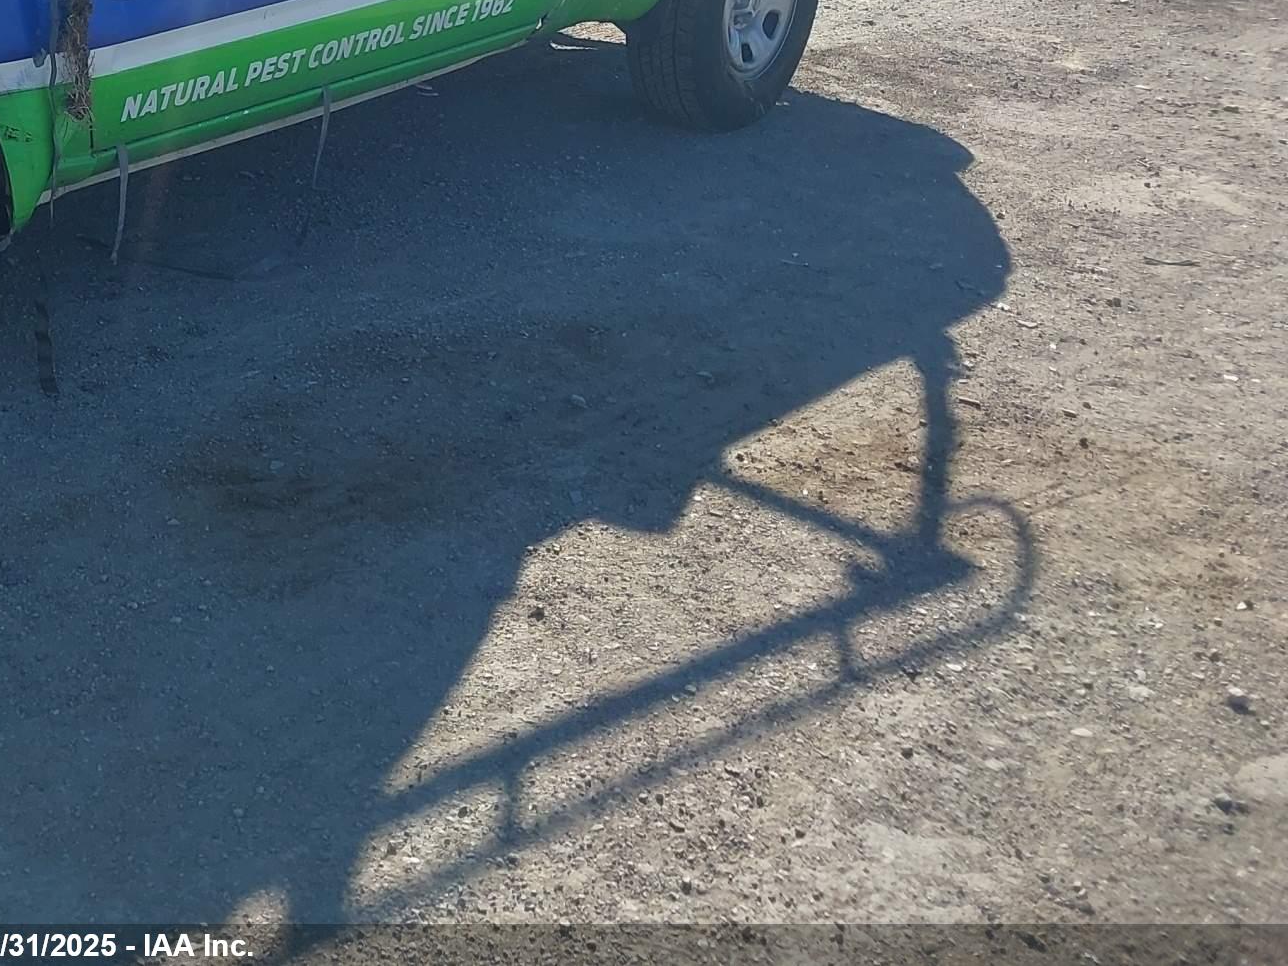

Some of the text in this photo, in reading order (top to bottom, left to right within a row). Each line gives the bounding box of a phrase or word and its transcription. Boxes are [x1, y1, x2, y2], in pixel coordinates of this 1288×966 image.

[120, 66, 239, 122] NATURAL
[244, 48, 307, 87] PEST
[308, 21, 405, 69] CONTROL
[409, 1, 471, 41] SINCE
